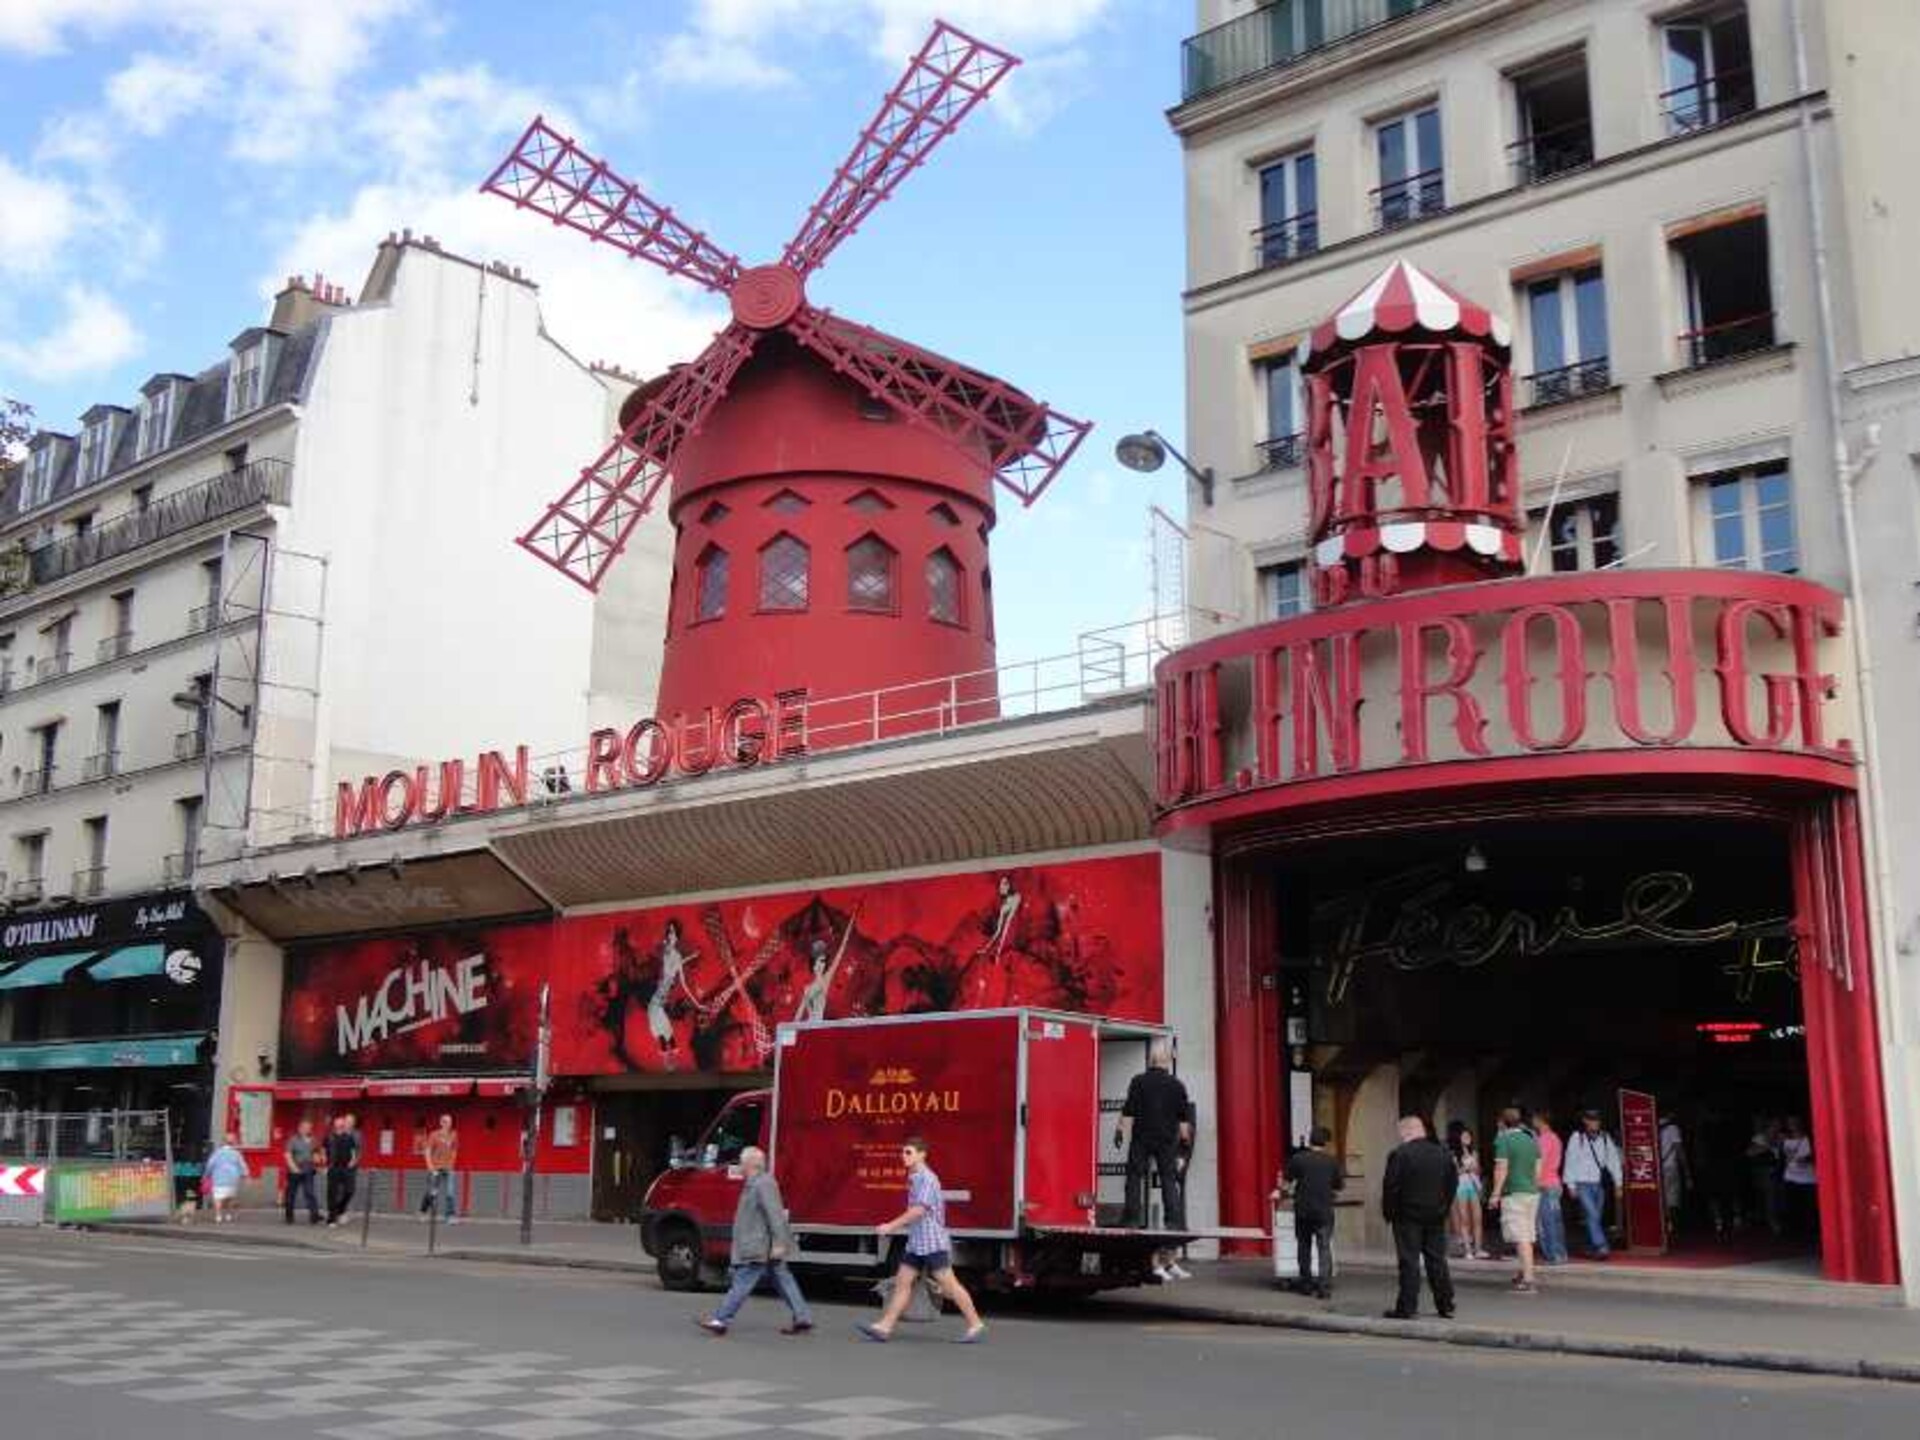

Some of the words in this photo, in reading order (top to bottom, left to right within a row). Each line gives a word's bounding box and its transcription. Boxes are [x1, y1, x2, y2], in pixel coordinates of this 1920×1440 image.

[1397, 595, 1862, 765] ROUGE
[333, 744, 529, 840] MOULIN
[584, 687, 808, 794] ROUGE
[336, 953, 489, 1055] MACHINE
[826, 1088, 960, 1118] DALLOYAU
